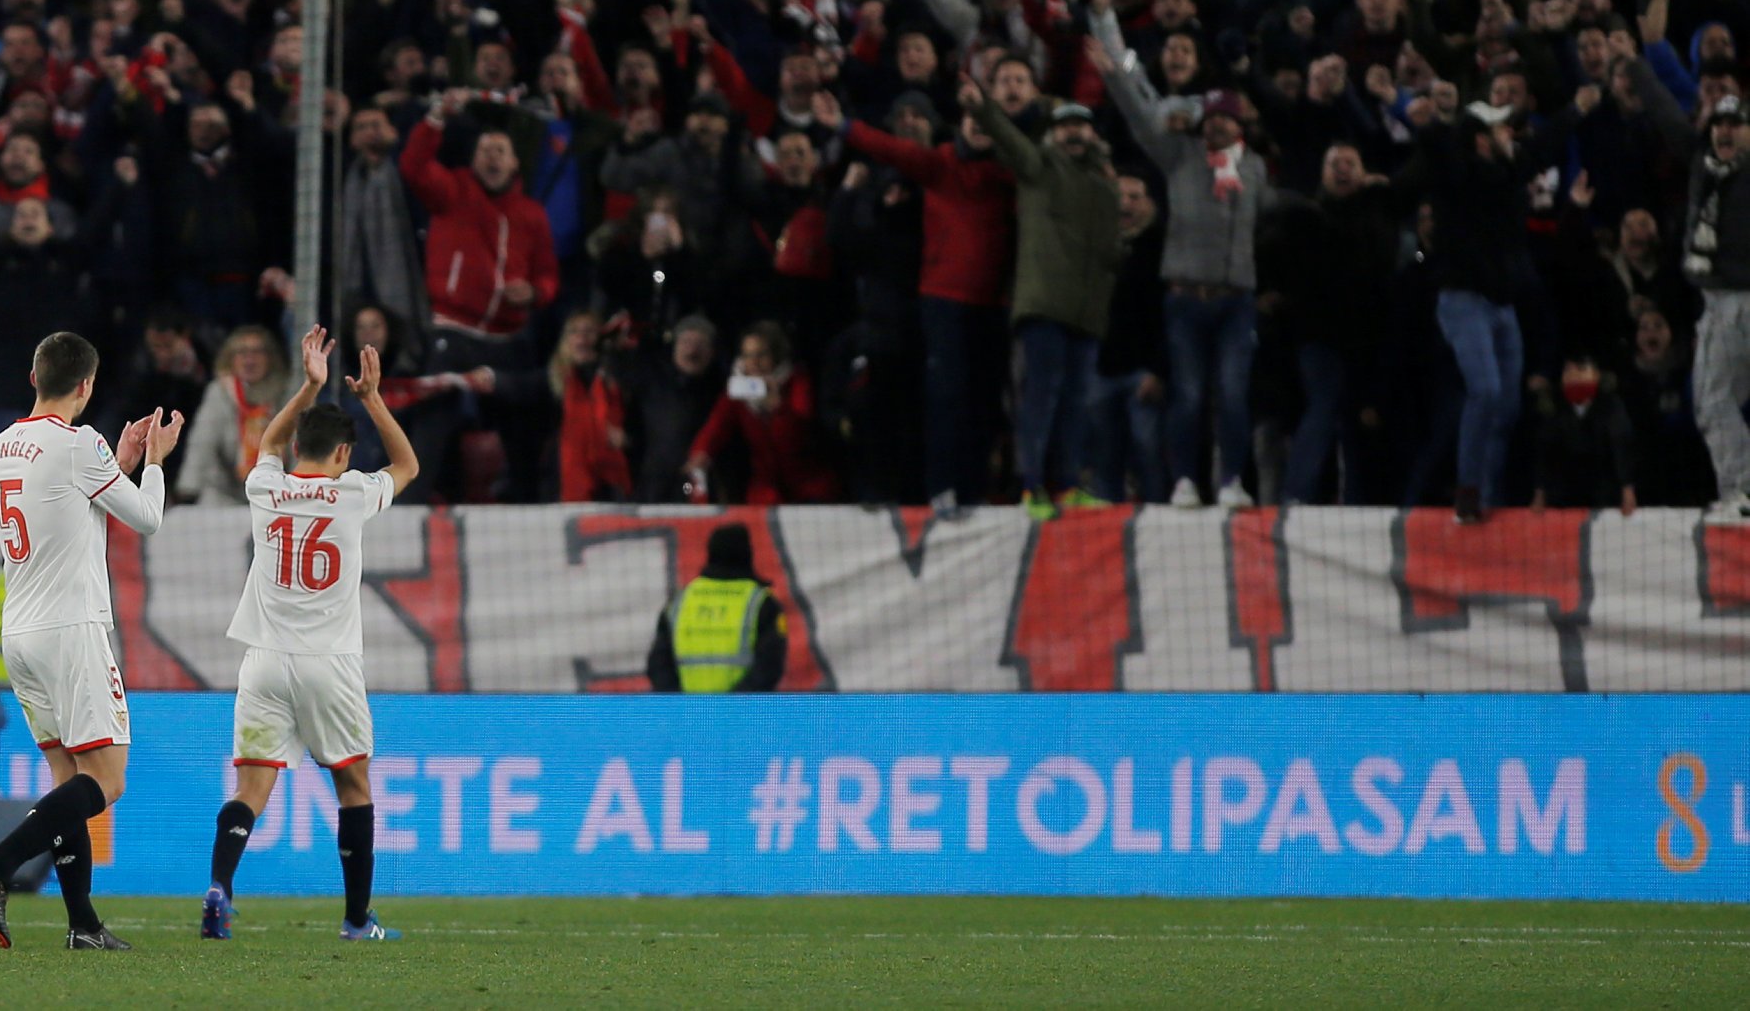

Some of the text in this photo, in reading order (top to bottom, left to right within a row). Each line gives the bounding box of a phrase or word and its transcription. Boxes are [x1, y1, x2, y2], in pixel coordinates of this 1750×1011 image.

[266, 516, 342, 594] 16
[575, 757, 710, 853] AL
[748, 755, 1587, 856] #RETOLIPASAM
